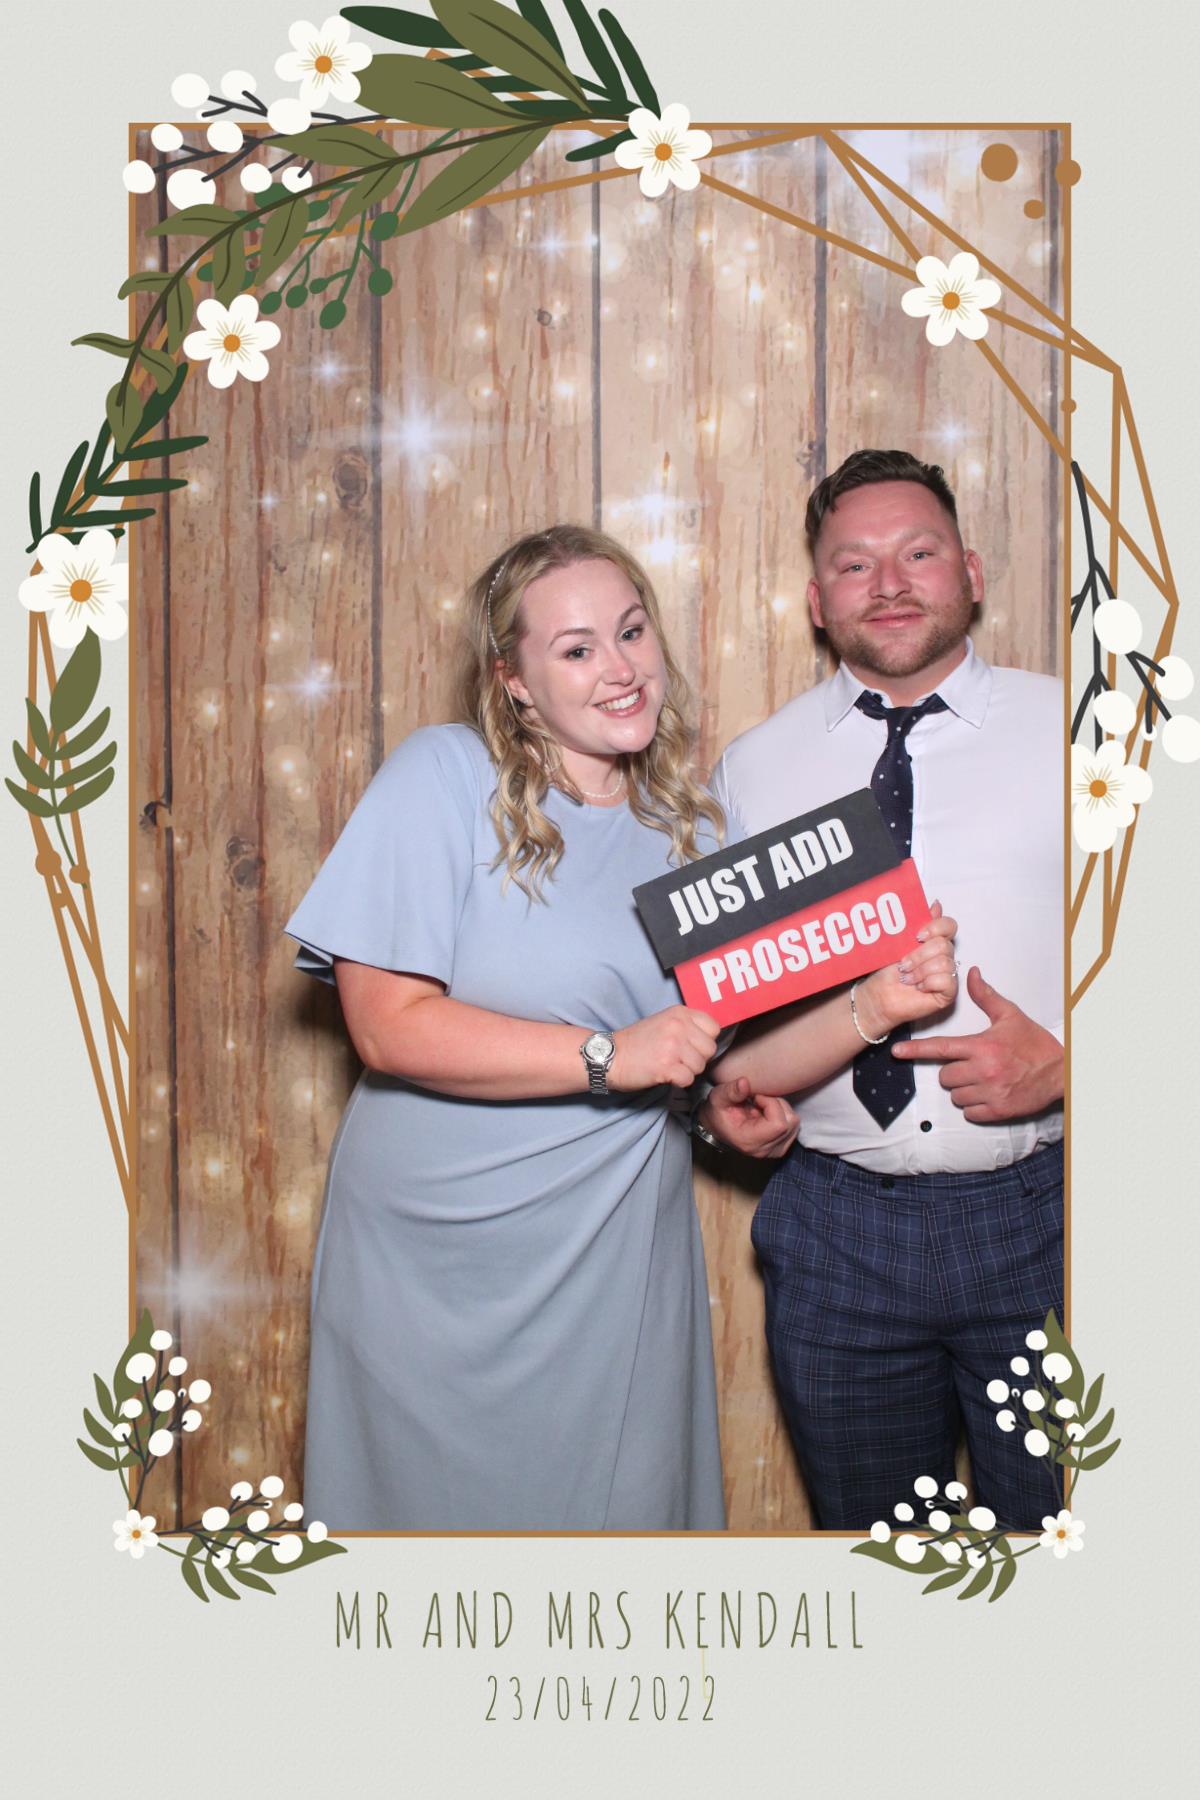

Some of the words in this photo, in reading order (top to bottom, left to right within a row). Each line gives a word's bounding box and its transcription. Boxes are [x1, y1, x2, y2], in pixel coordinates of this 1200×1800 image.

[668, 855, 765, 936] JUST
[768, 818, 854, 890] ADD
[699, 892, 907, 1003] PROSECCO
